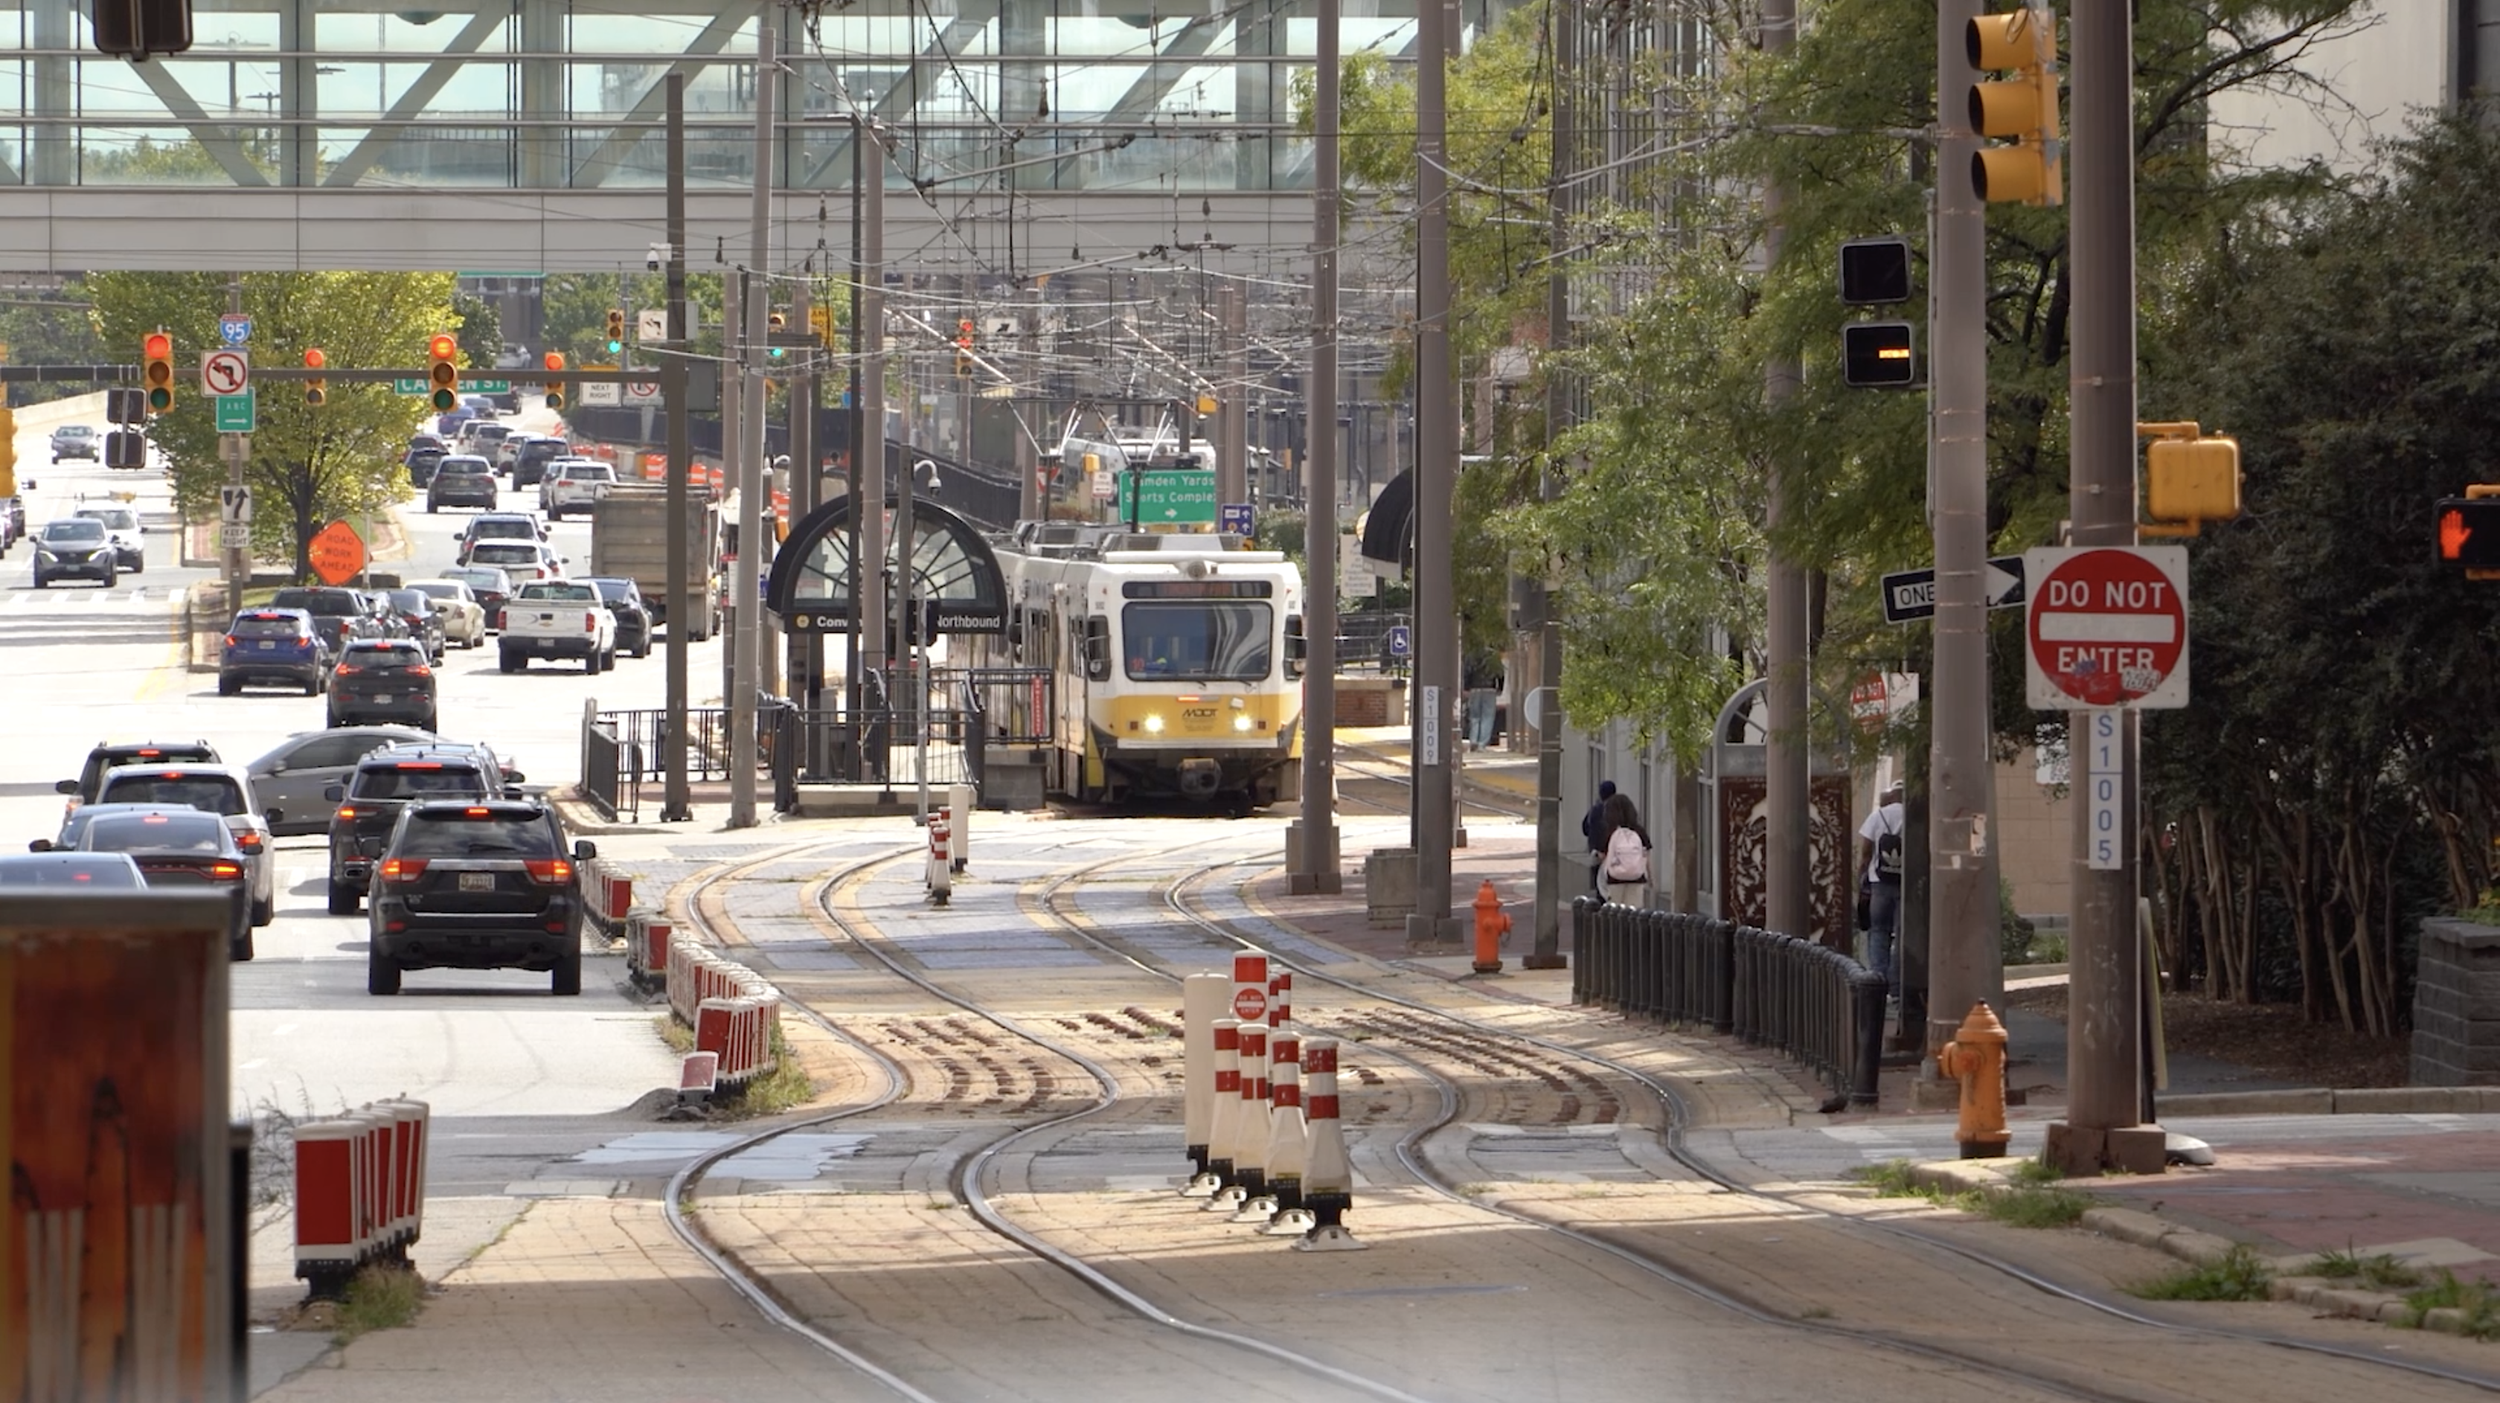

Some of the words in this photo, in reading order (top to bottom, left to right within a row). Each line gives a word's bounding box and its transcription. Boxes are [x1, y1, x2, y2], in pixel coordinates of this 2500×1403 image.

[225, 323, 245, 340] 95
[401, 379, 476, 391] CAEN
[1181, 475, 1215, 487] Yards
[1125, 491, 1165, 503] Sorts
[224, 528, 246, 536] KEEP
[223, 537, 247, 545] RIGHT
[326, 533, 354, 545] ROAD
[324, 547, 352, 558] WORK
[320, 561, 354, 573] AHEAD
[1900, 584, 1935, 605] ONE
[2050, 580, 2090, 607] DO
[2105, 581, 2167, 609] NOT
[2058, 646, 2154, 674] ENTER
[2097, 714, 2113, 862] S1005
